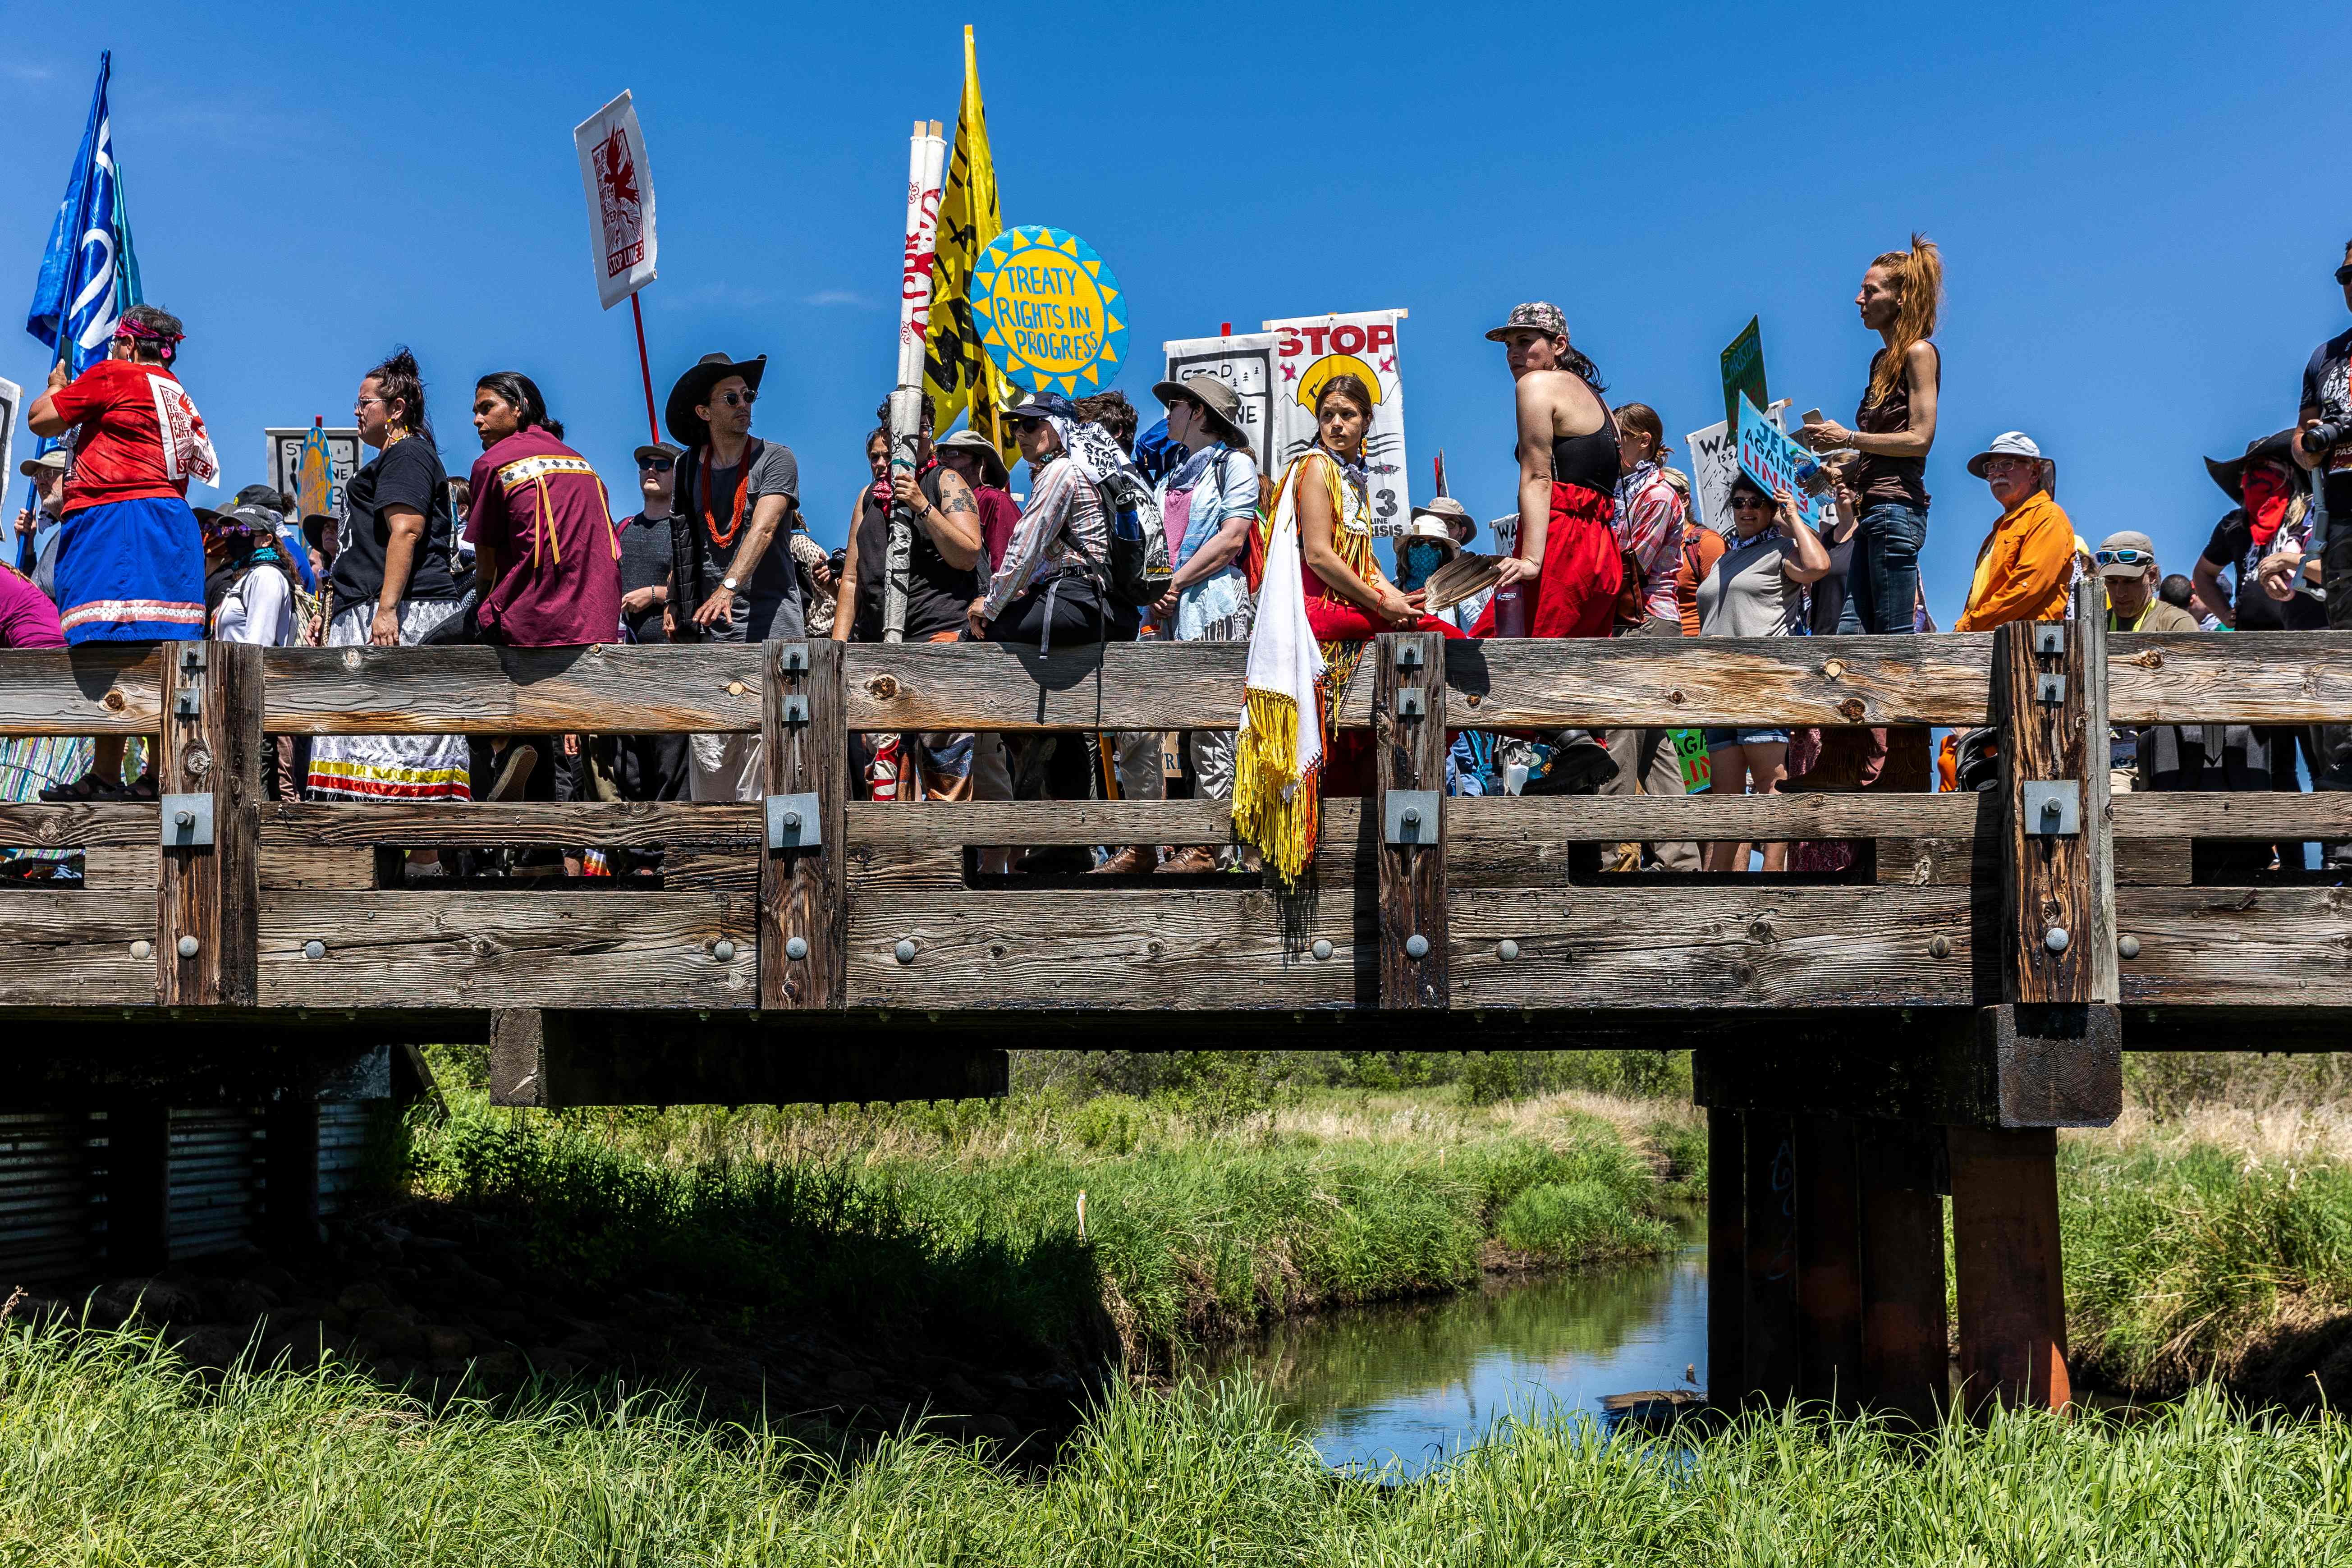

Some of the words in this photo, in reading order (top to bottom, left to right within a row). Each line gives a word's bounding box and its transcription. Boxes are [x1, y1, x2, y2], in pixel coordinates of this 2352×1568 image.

[609, 253, 623, 274] STOP
[624, 245, 638, 266] LINE
[639, 243, 643, 259] 3
[1003, 266, 1077, 296] TREATY
[995, 297, 1064, 330] RIGHTS
[1068, 306, 1091, 328] IN
[1014, 330, 1098, 361] PROGRESS
[1273, 325, 1394, 357] STOP
[1233, 406, 1257, 424] NE
[173, 422, 188, 430] THE
[285, 443, 303, 456] ST
[1756, 421, 1793, 466] JEW
[1087, 455, 1115, 471] LINE
[1717, 453, 1726, 463] IS
[1744, 428, 1792, 481] AGAIN
[179, 461, 188, 472] ST
[189, 458, 204, 474] INE
[203, 466, 211, 477] 3
[333, 468, 348, 480] NE
[1098, 468, 1107, 478] 3
[332, 486, 344, 505] 3
[1375, 489, 1398, 517] 3
[1798, 491, 1809, 513] 3
[1372, 524, 1403, 537] ISIS
